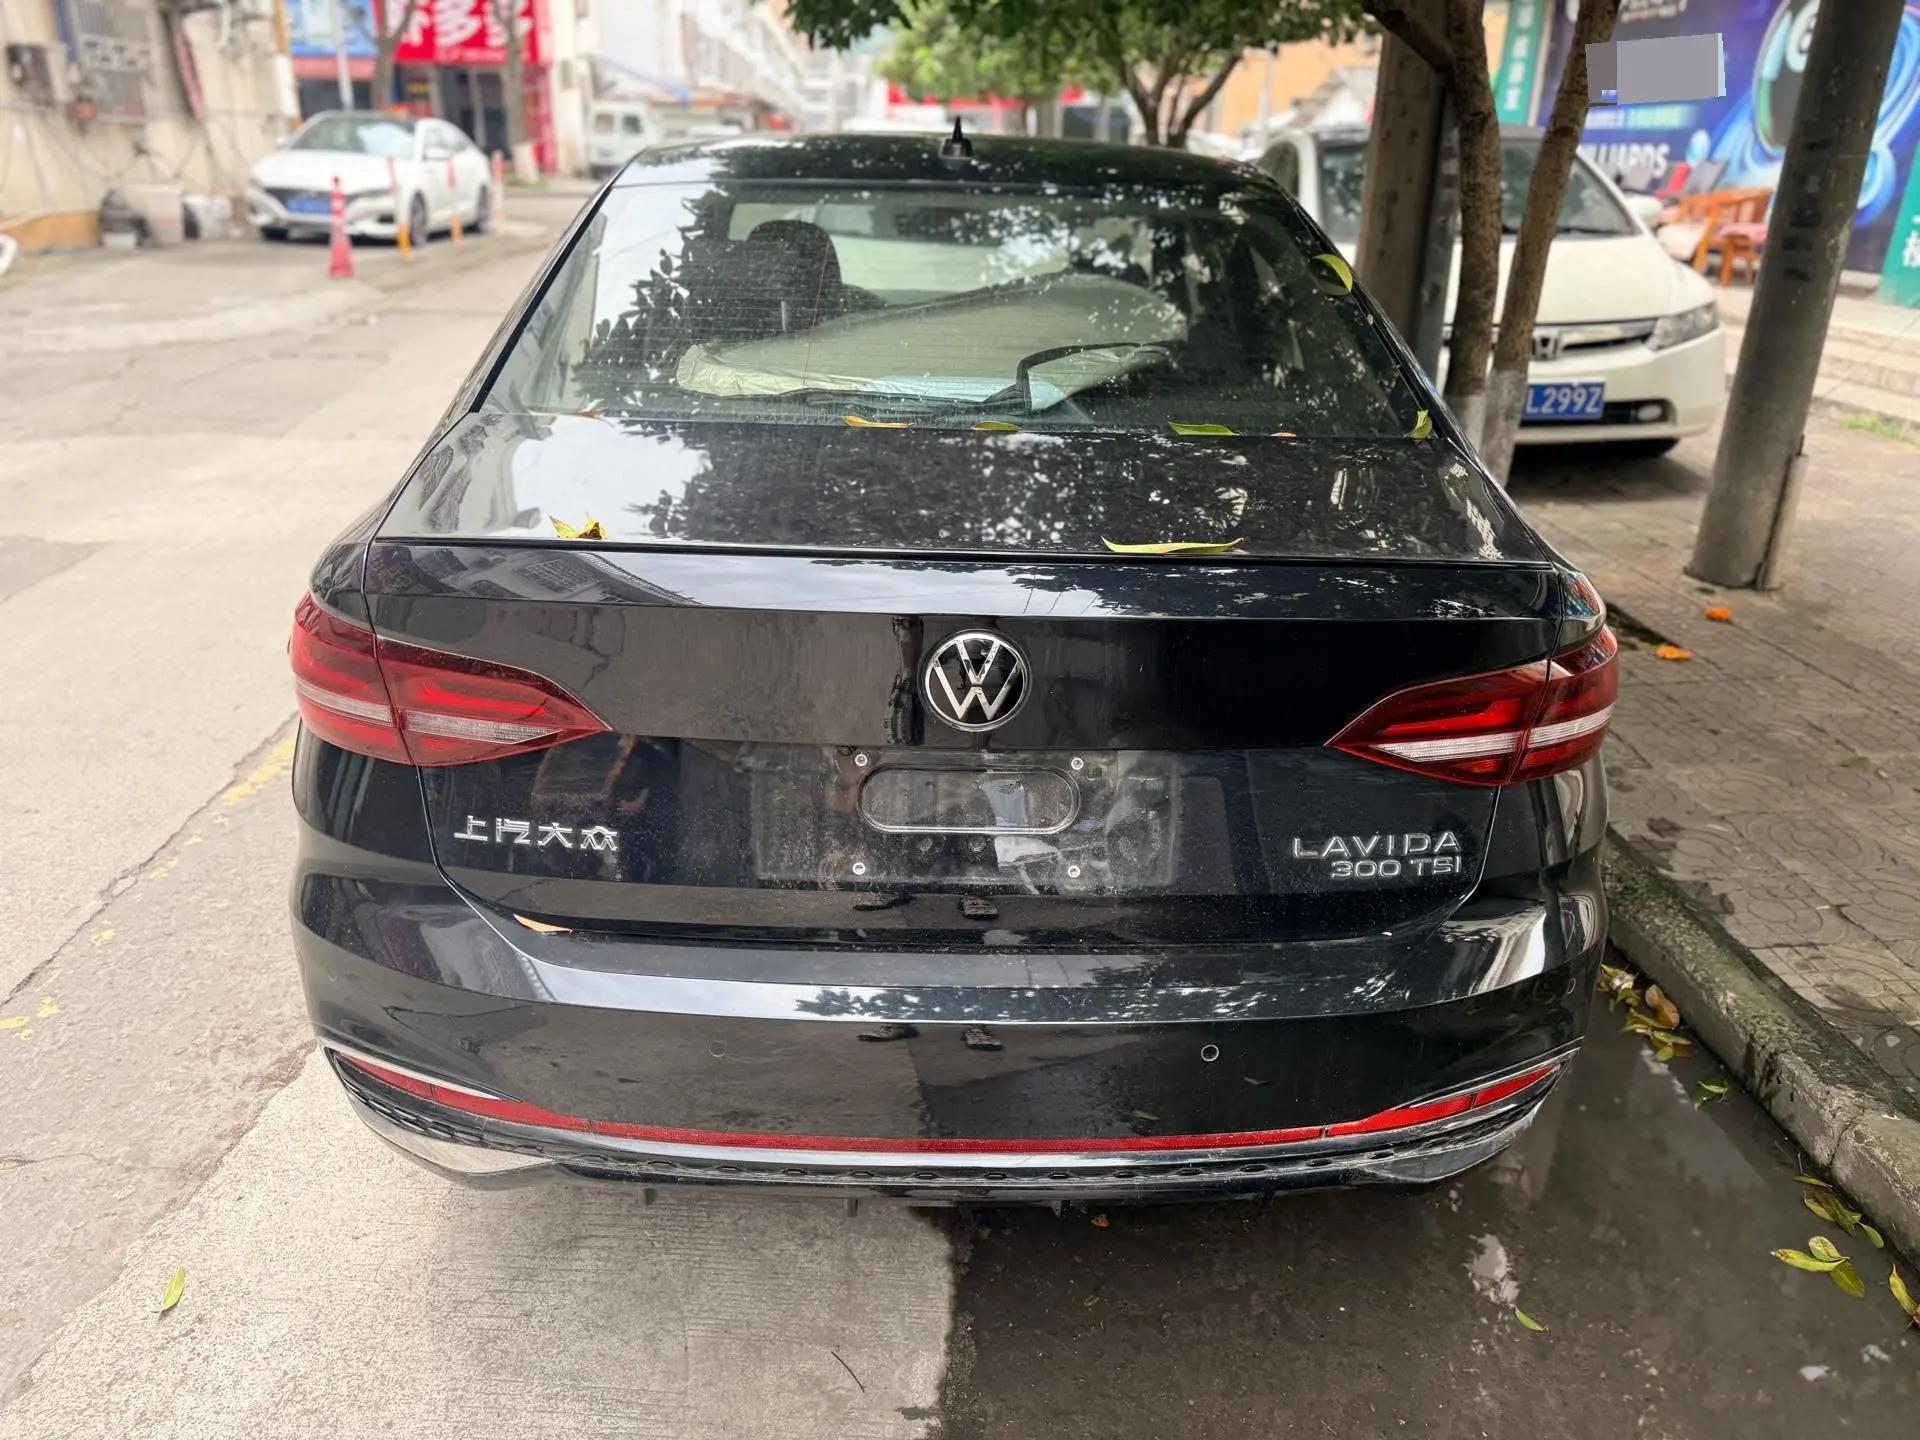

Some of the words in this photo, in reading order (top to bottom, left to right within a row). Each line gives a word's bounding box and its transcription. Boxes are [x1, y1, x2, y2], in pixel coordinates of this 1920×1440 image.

[1525, 386, 1603, 414] L299Z
[453, 815, 618, 852] 上汽大众
[1293, 831, 1462, 858] LAVIDA
[1331, 859, 1402, 879] 300
[1410, 855, 1462, 877] TSI
